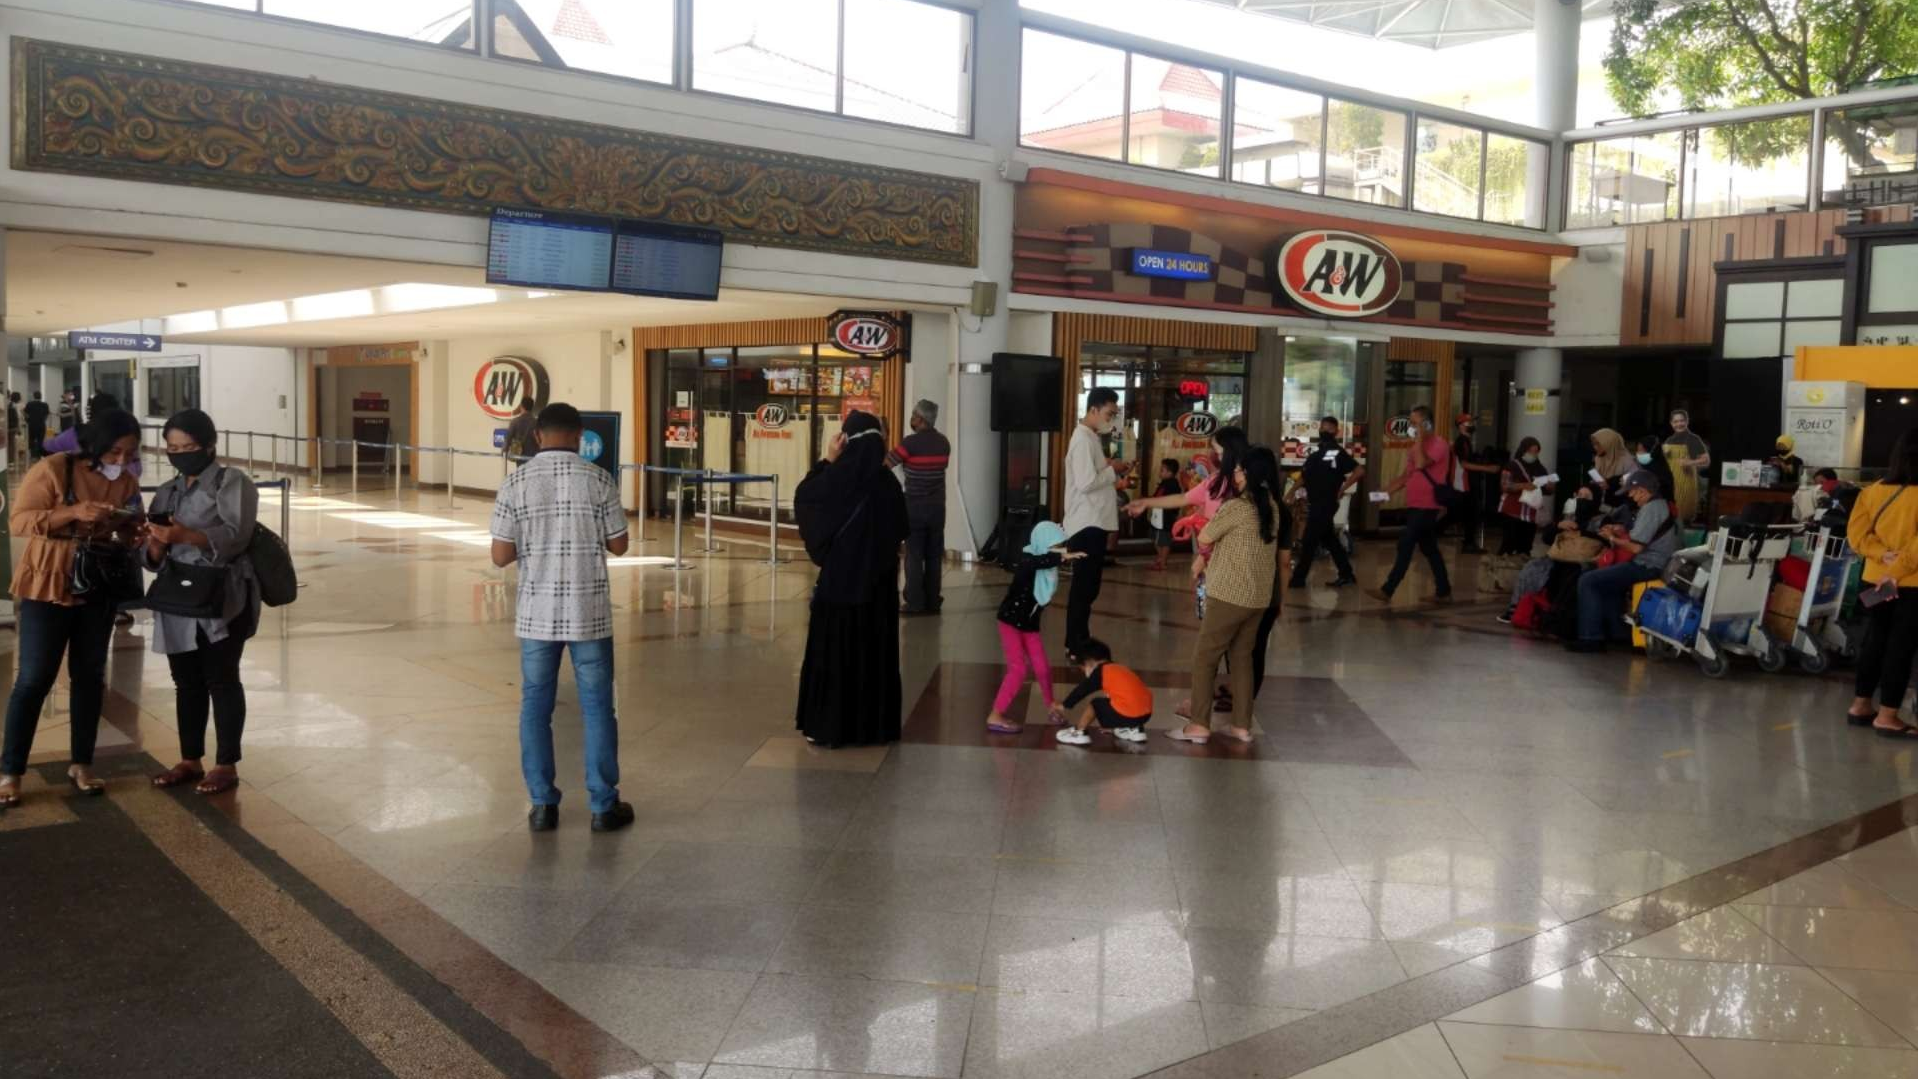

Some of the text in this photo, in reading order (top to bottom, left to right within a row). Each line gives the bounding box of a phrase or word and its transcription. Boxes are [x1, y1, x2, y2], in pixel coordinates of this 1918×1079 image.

[496, 207, 544, 219] Departure
[1138, 255, 1209, 274] OPEN 24 HOURS
[1299, 248, 1387, 299] A&W
[79, 336, 136, 346] ATM CENTER
[1179, 381, 1208, 396] OPEN
